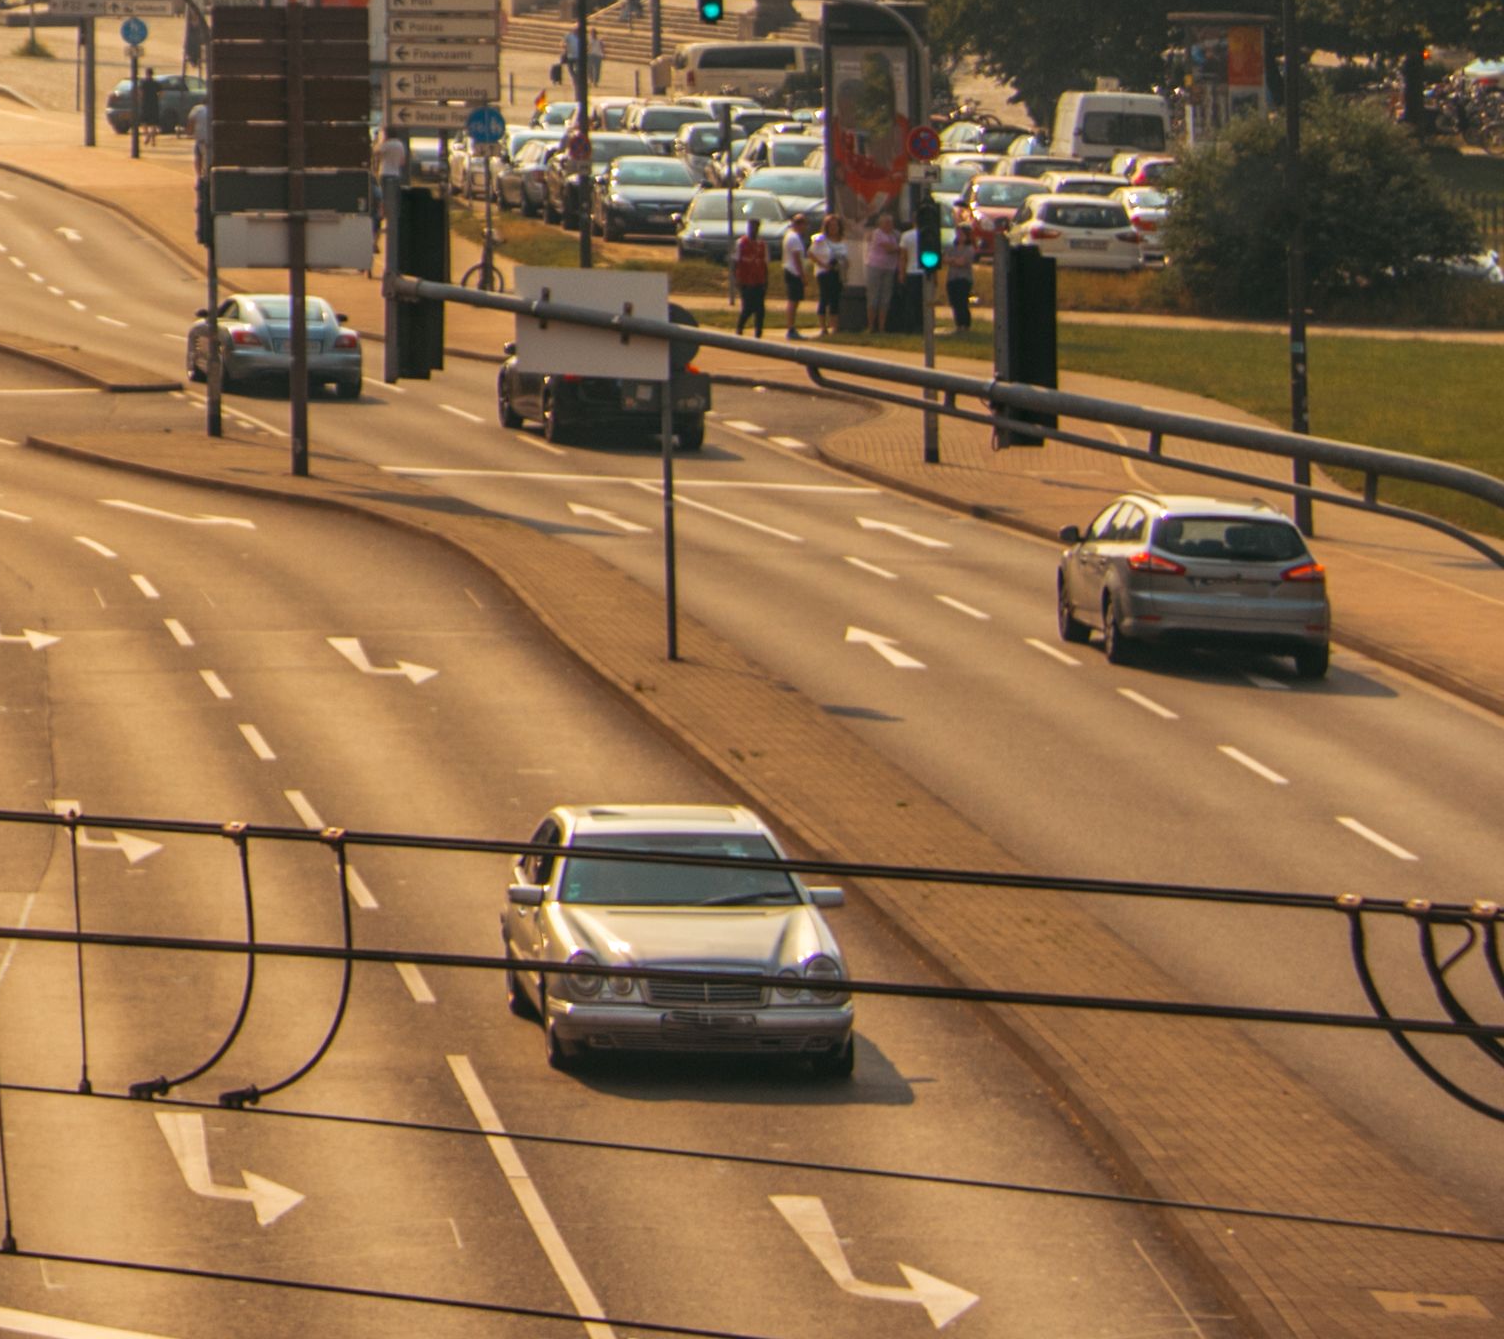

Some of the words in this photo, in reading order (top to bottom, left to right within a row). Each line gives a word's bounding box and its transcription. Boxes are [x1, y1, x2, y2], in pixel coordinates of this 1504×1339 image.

[413, 48, 472, 60] Finanzamt
[413, 74, 437, 84] DJH
[414, 87, 488, 99] Berufskolleg
